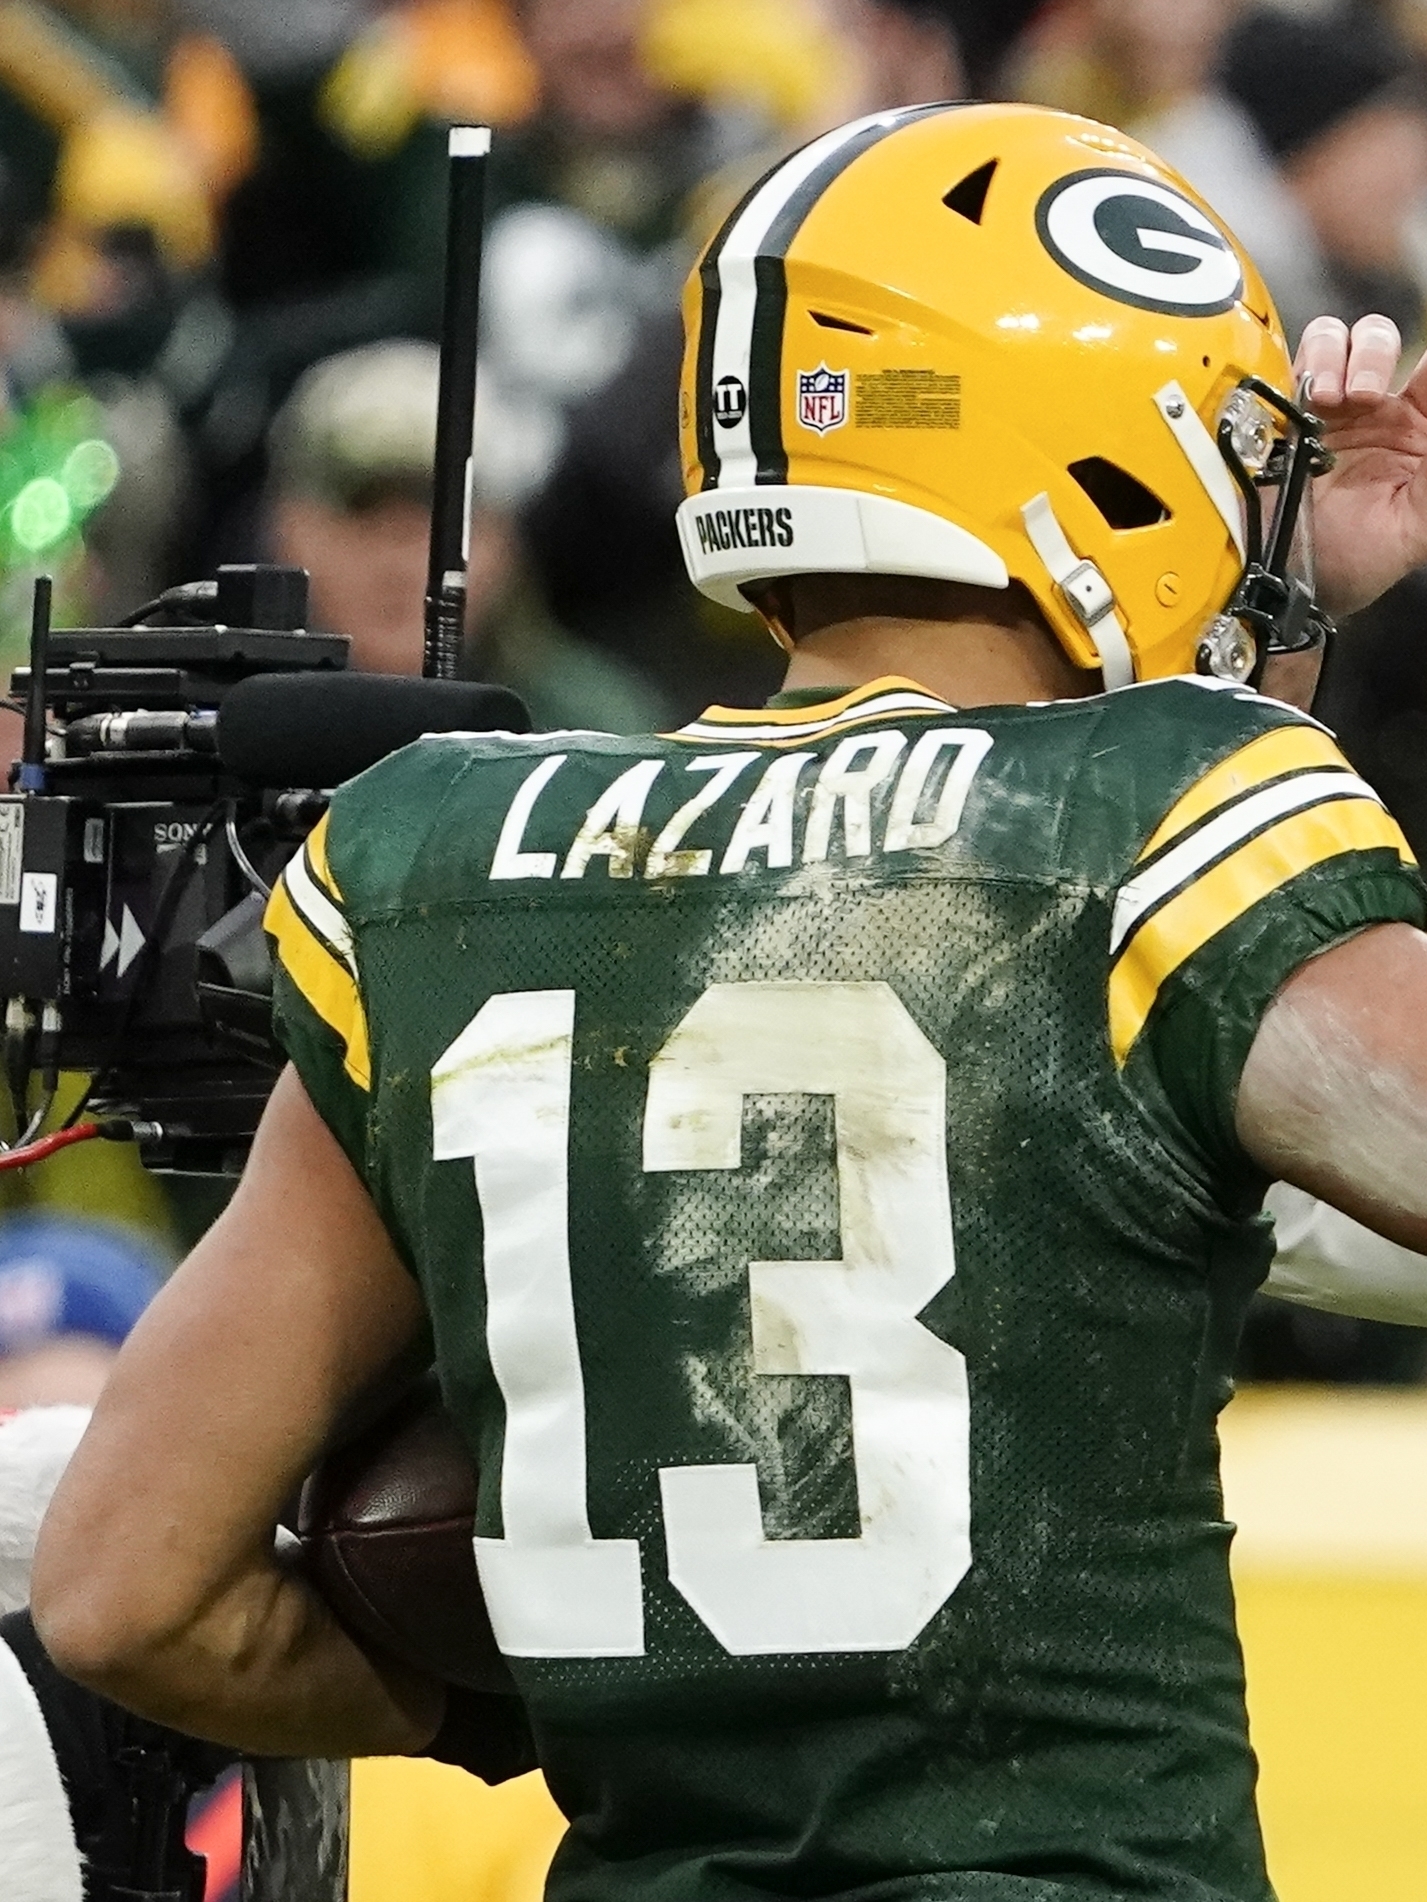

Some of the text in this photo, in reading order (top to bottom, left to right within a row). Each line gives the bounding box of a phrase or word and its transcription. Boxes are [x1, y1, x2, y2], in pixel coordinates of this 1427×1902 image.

[1043, 173, 1243, 308] G
[803, 395, 840, 423] NFL
[695, 507, 794, 555] PACKERS
[489, 728, 995, 880] LAZARD
[430, 980, 974, 1658] 13
